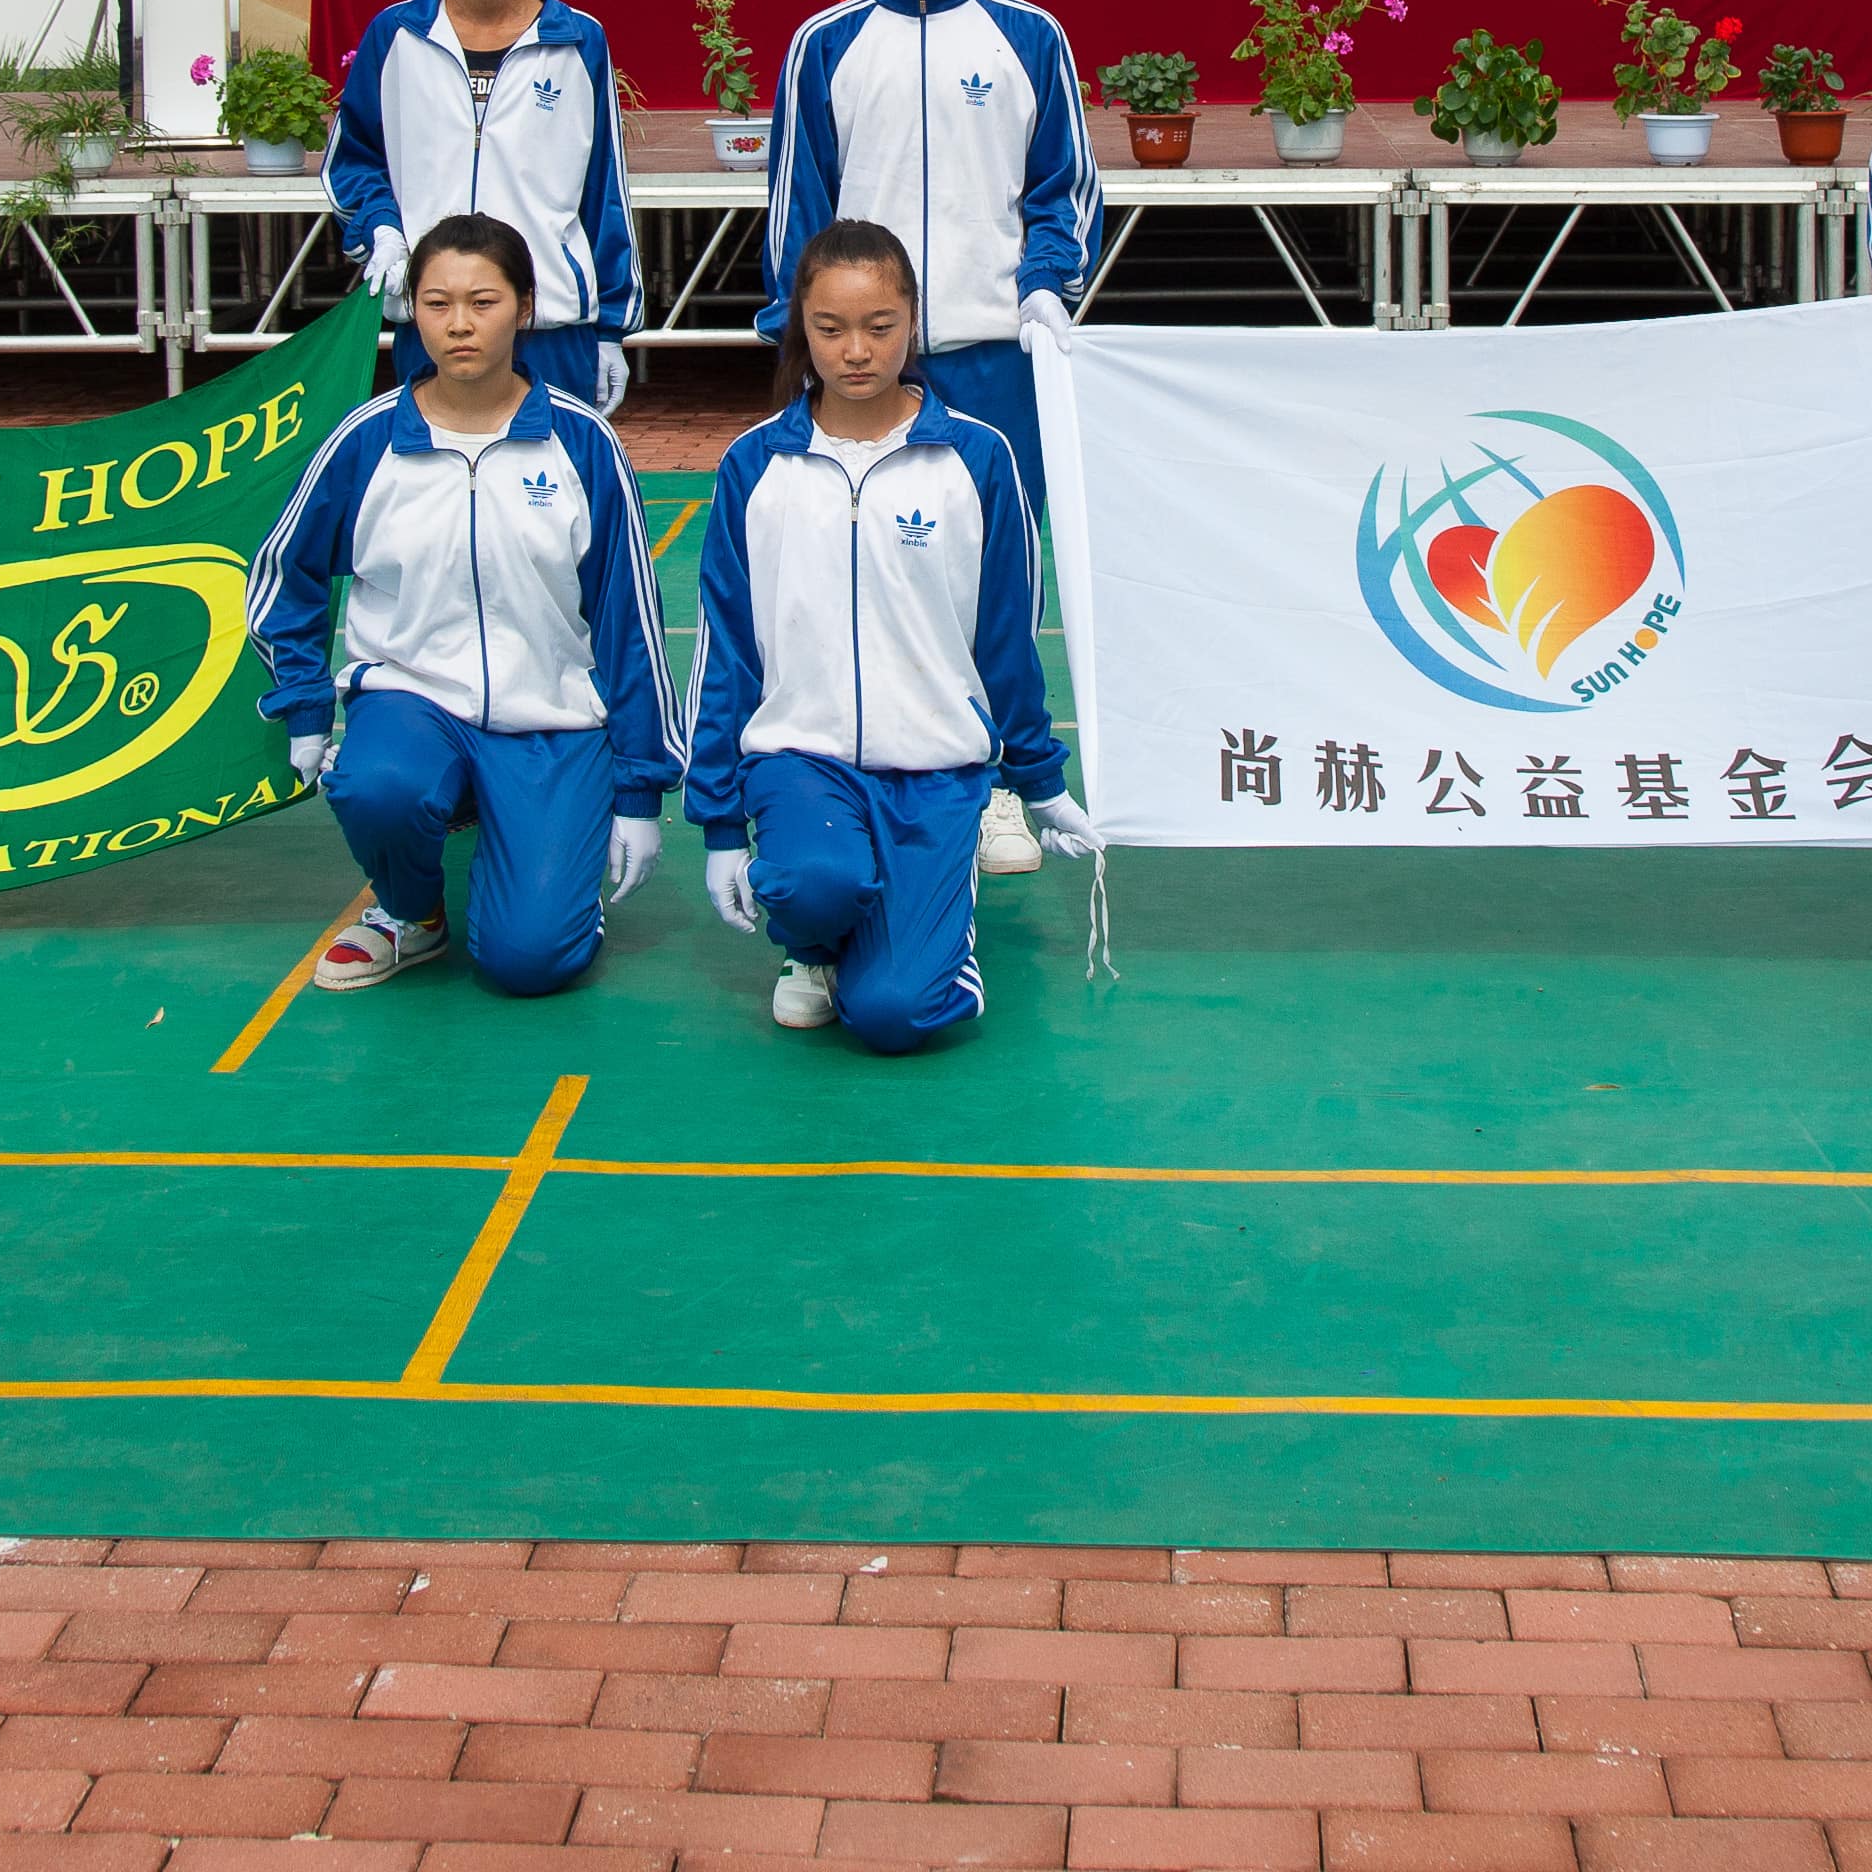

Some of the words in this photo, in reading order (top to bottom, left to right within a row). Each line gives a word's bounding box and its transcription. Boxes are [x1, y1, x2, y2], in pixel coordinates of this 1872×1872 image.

[33, 382, 307, 534] HOPE
[900, 539, 928, 549] xinbin
[1617, 592, 1683, 667] HOPE
